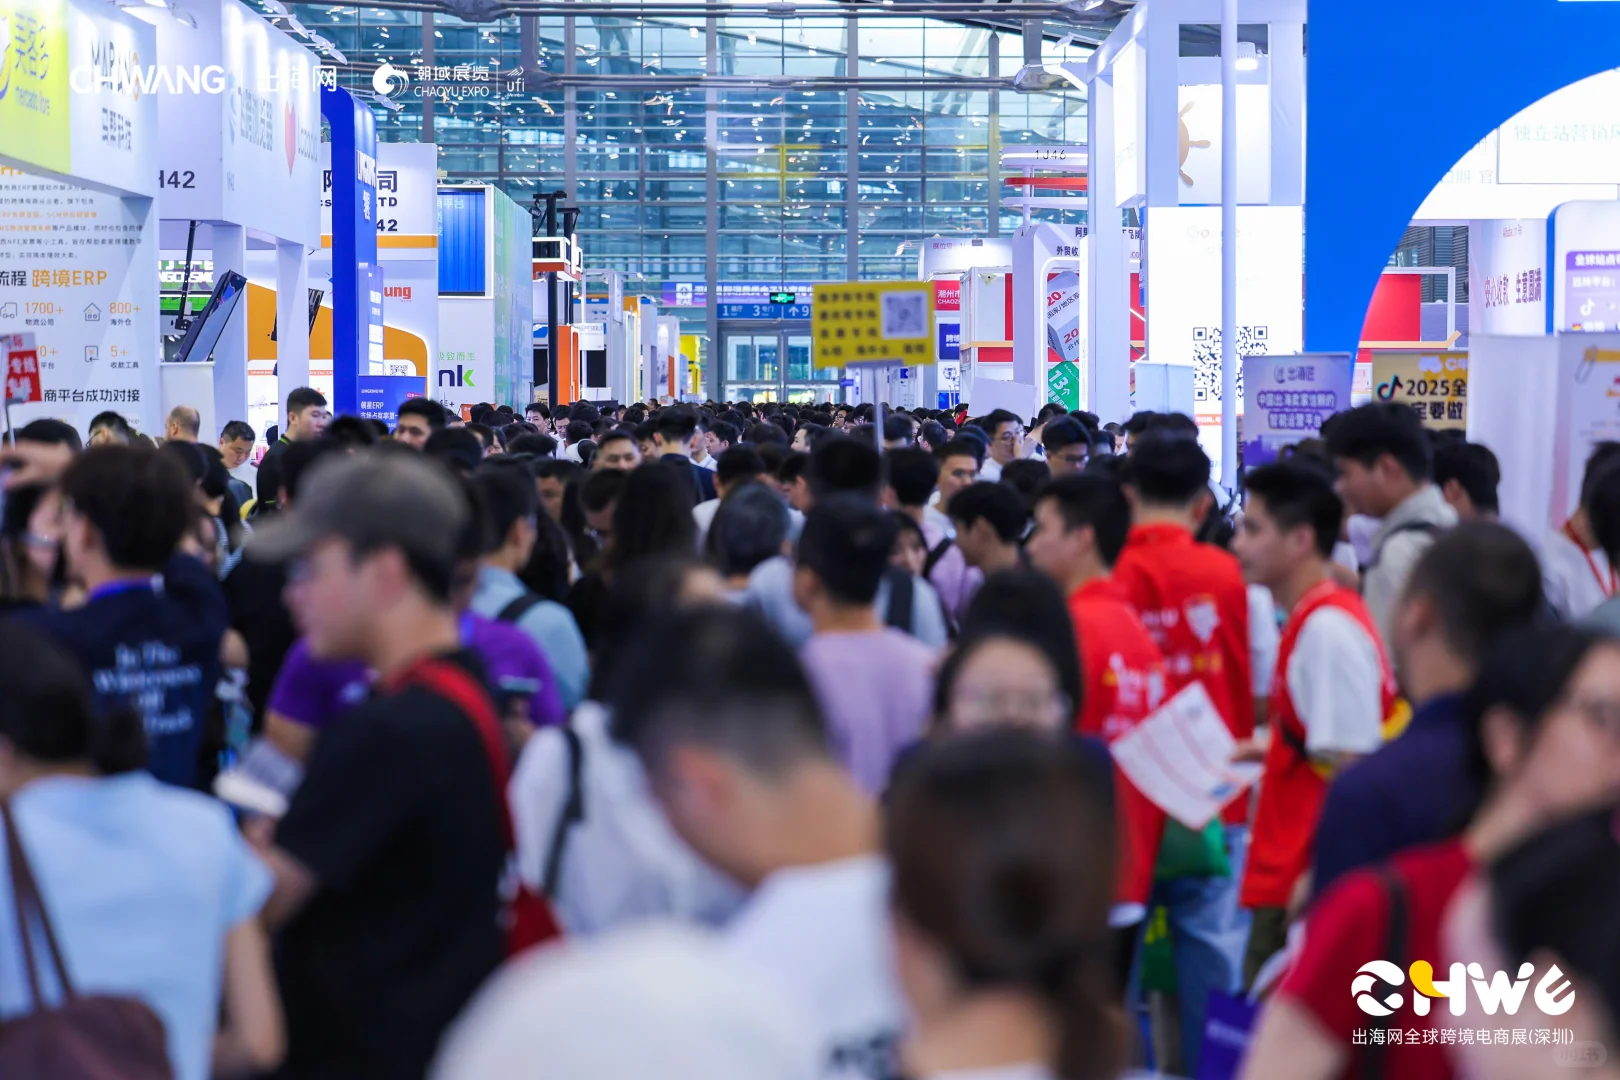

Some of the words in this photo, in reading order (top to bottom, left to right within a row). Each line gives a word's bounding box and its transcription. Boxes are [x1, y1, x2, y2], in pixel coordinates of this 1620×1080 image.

[1034, 149, 1067, 160] 1J46
[377, 170, 398, 193] 司
[376, 196, 398, 207] TD
[376, 218, 398, 232] 42
[32, 269, 108, 288] 跨境ERP
[24, 302, 64, 315] 1700+
[109, 302, 141, 315] 800+
[722, 305, 729, 317] 1
[752, 305, 761, 317] 3
[25, 318, 55, 327] 物流公司
[110, 318, 132, 327] 海外仓
[37, 345, 58, 357] 0+
[111, 345, 128, 357] 5+
[110, 361, 140, 370] 收款工具
[44, 389, 141, 402] 商平台成功对接
